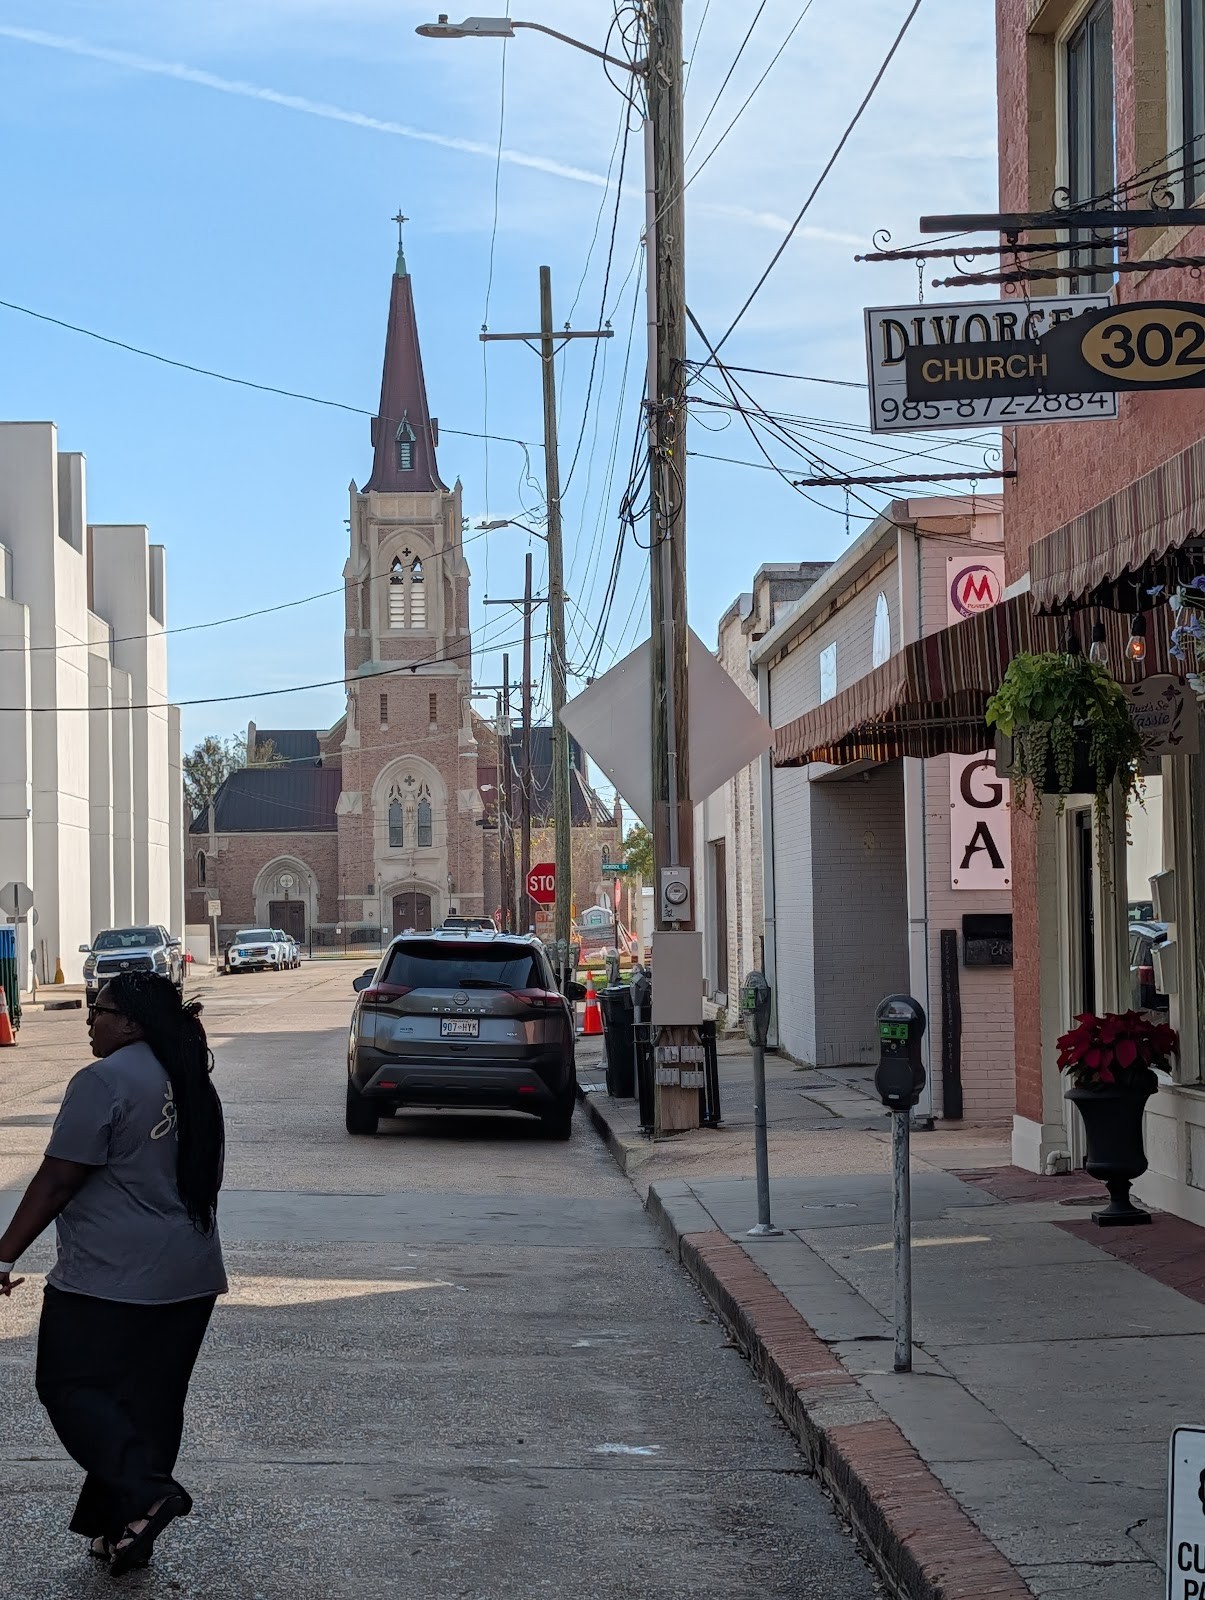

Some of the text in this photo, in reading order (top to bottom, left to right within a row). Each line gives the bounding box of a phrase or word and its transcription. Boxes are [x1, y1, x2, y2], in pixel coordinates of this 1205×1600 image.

[1101, 322, 1205, 369] 302
[922, 354, 1048, 383] CHURCH
[880, 392, 1108, 422] 985-872-2884
[963, 572, 994, 604] M
[529, 875, 555, 891] STO
[442, 1022, 457, 1032] 907
